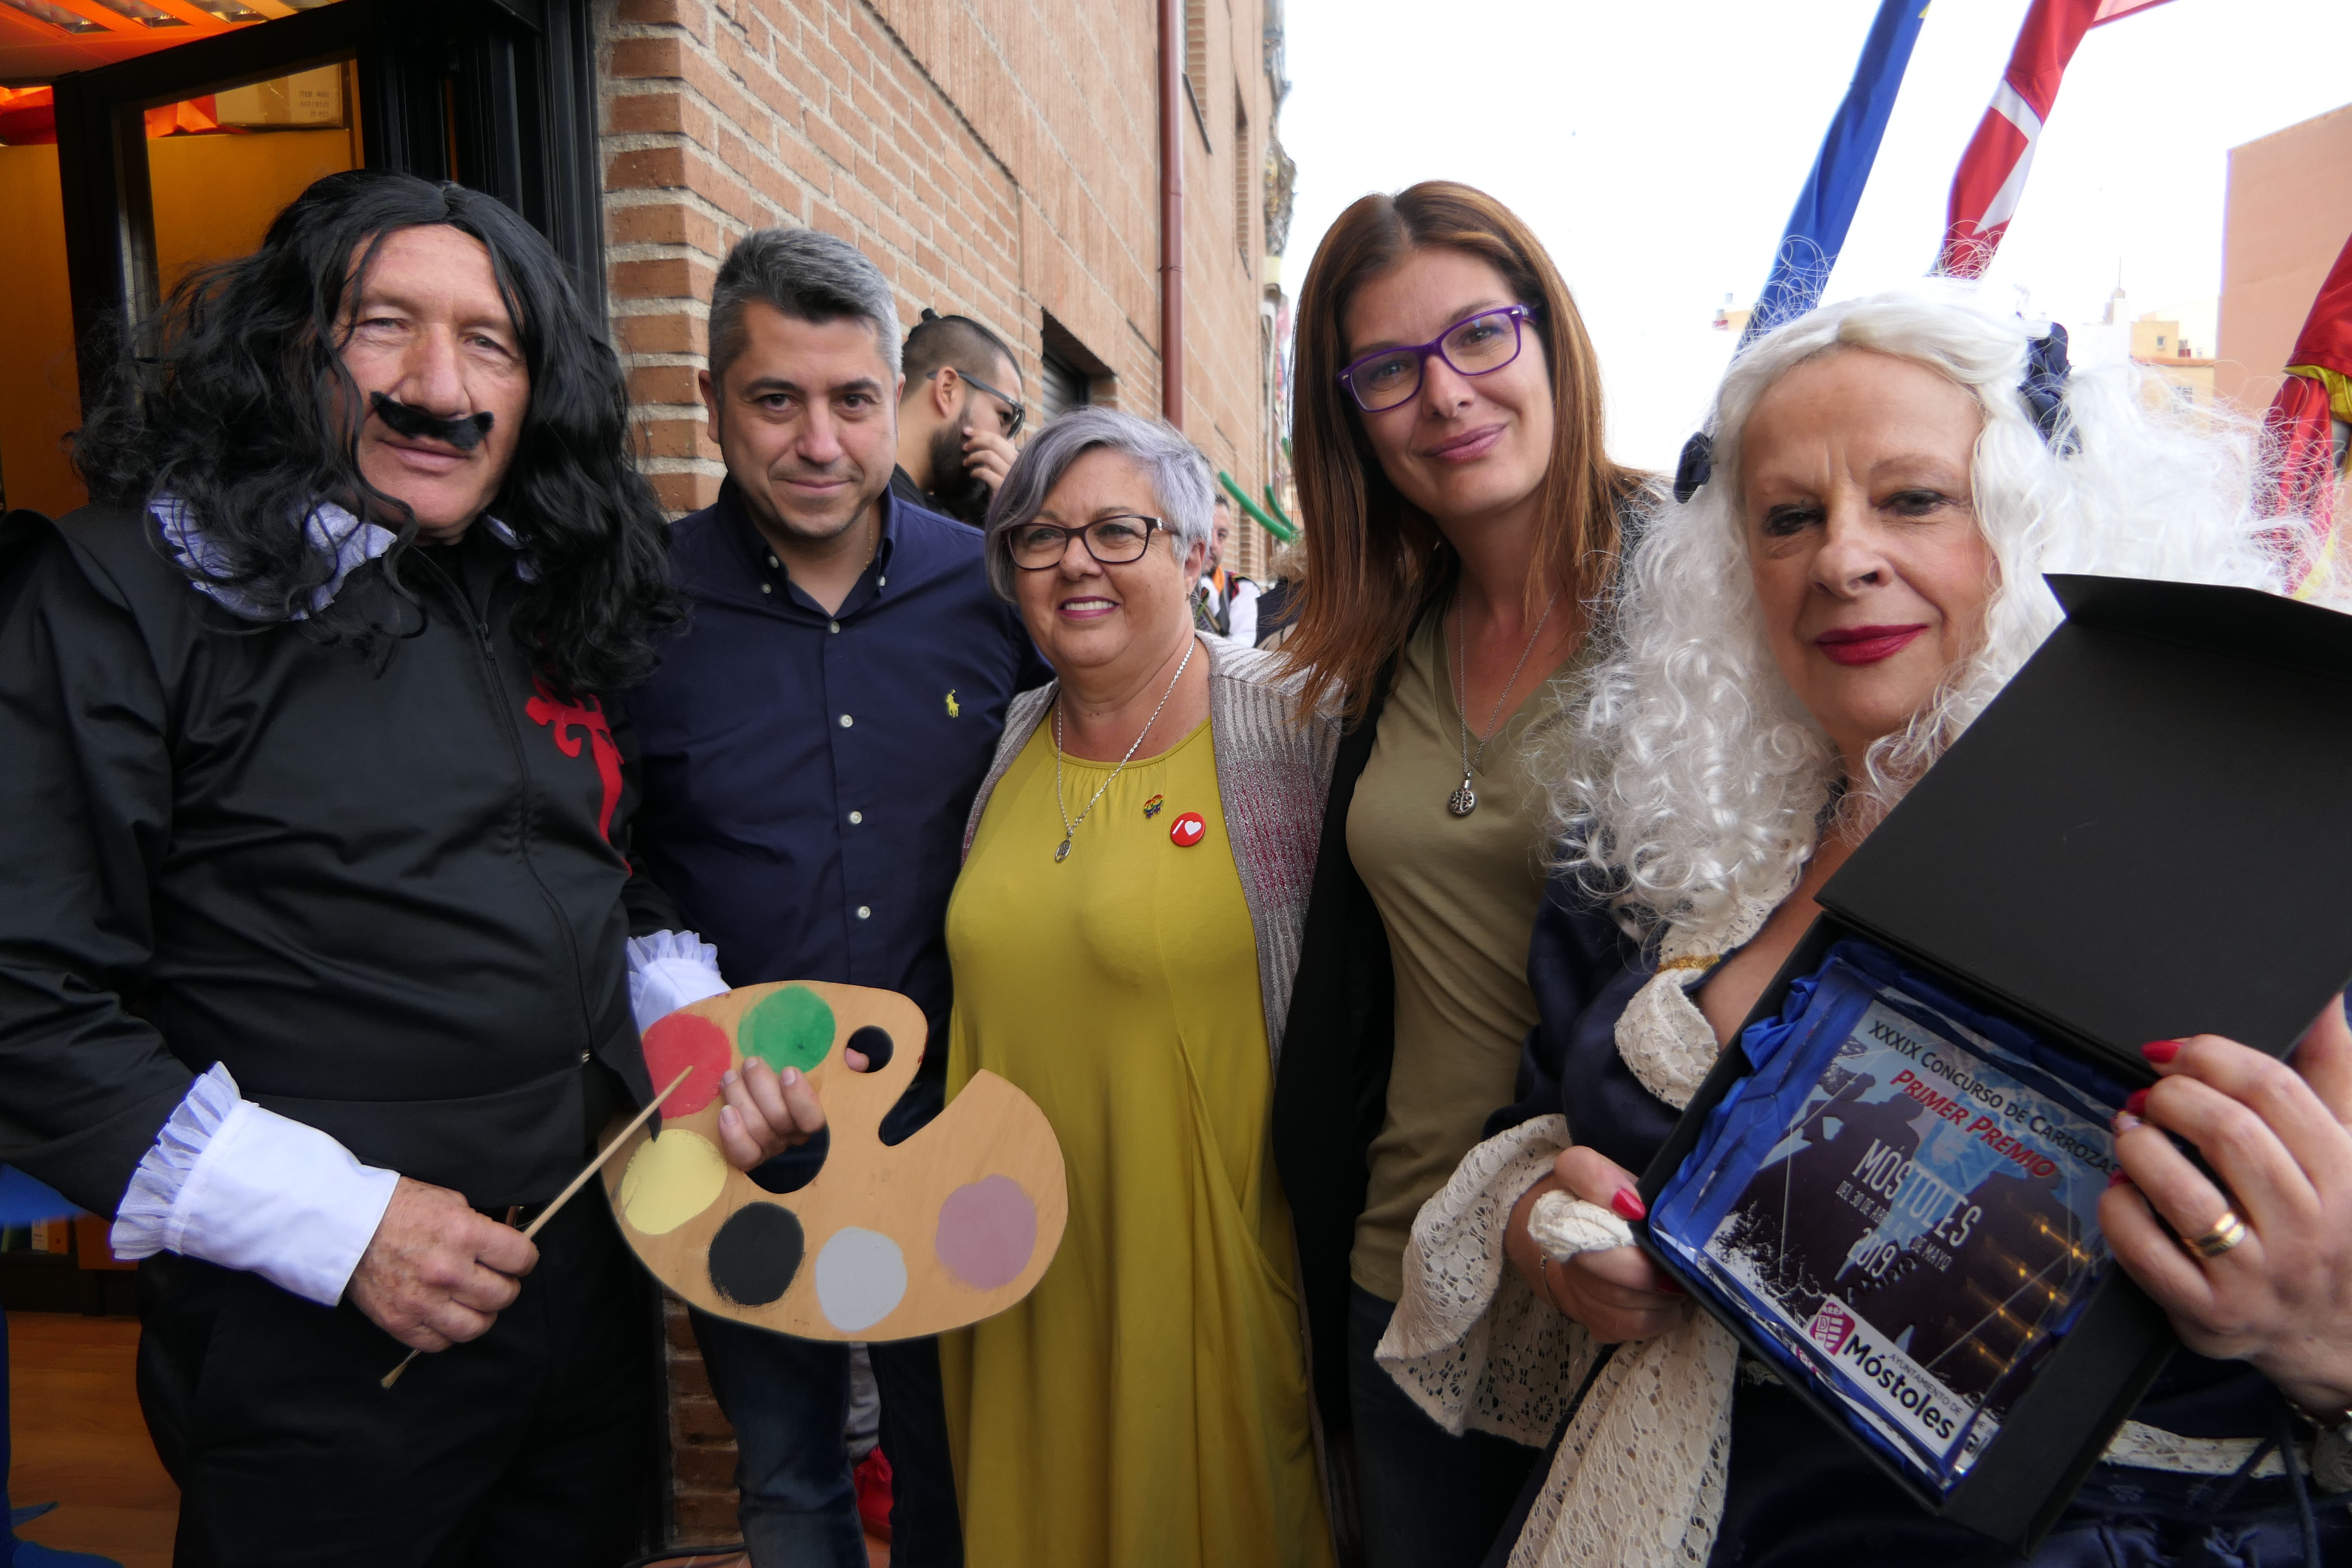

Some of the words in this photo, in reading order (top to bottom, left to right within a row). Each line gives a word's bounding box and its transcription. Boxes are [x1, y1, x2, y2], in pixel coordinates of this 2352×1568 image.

[1868, 1020, 1922, 1060] XXXIX
[1920, 1052, 2003, 1108] CONCURSO
[2004, 1101, 2029, 1124] DE
[1889, 1069, 1969, 1126] PRIMER
[1965, 1115, 2056, 1176] PREMIO
[1835, 1180, 1853, 1200] DEL
[1859, 1197, 1875, 1215] DE
[1921, 1242, 1953, 1271] MAYO
[1852, 1138, 1982, 1246] MÓSTOLES
[1847, 1227, 1896, 1277] 2019
[1843, 1334, 1954, 1439] Móstoles
[1889, 1353, 1950, 1405] AYUNTAMIENTO
[1949, 1402, 1963, 1416] DE
